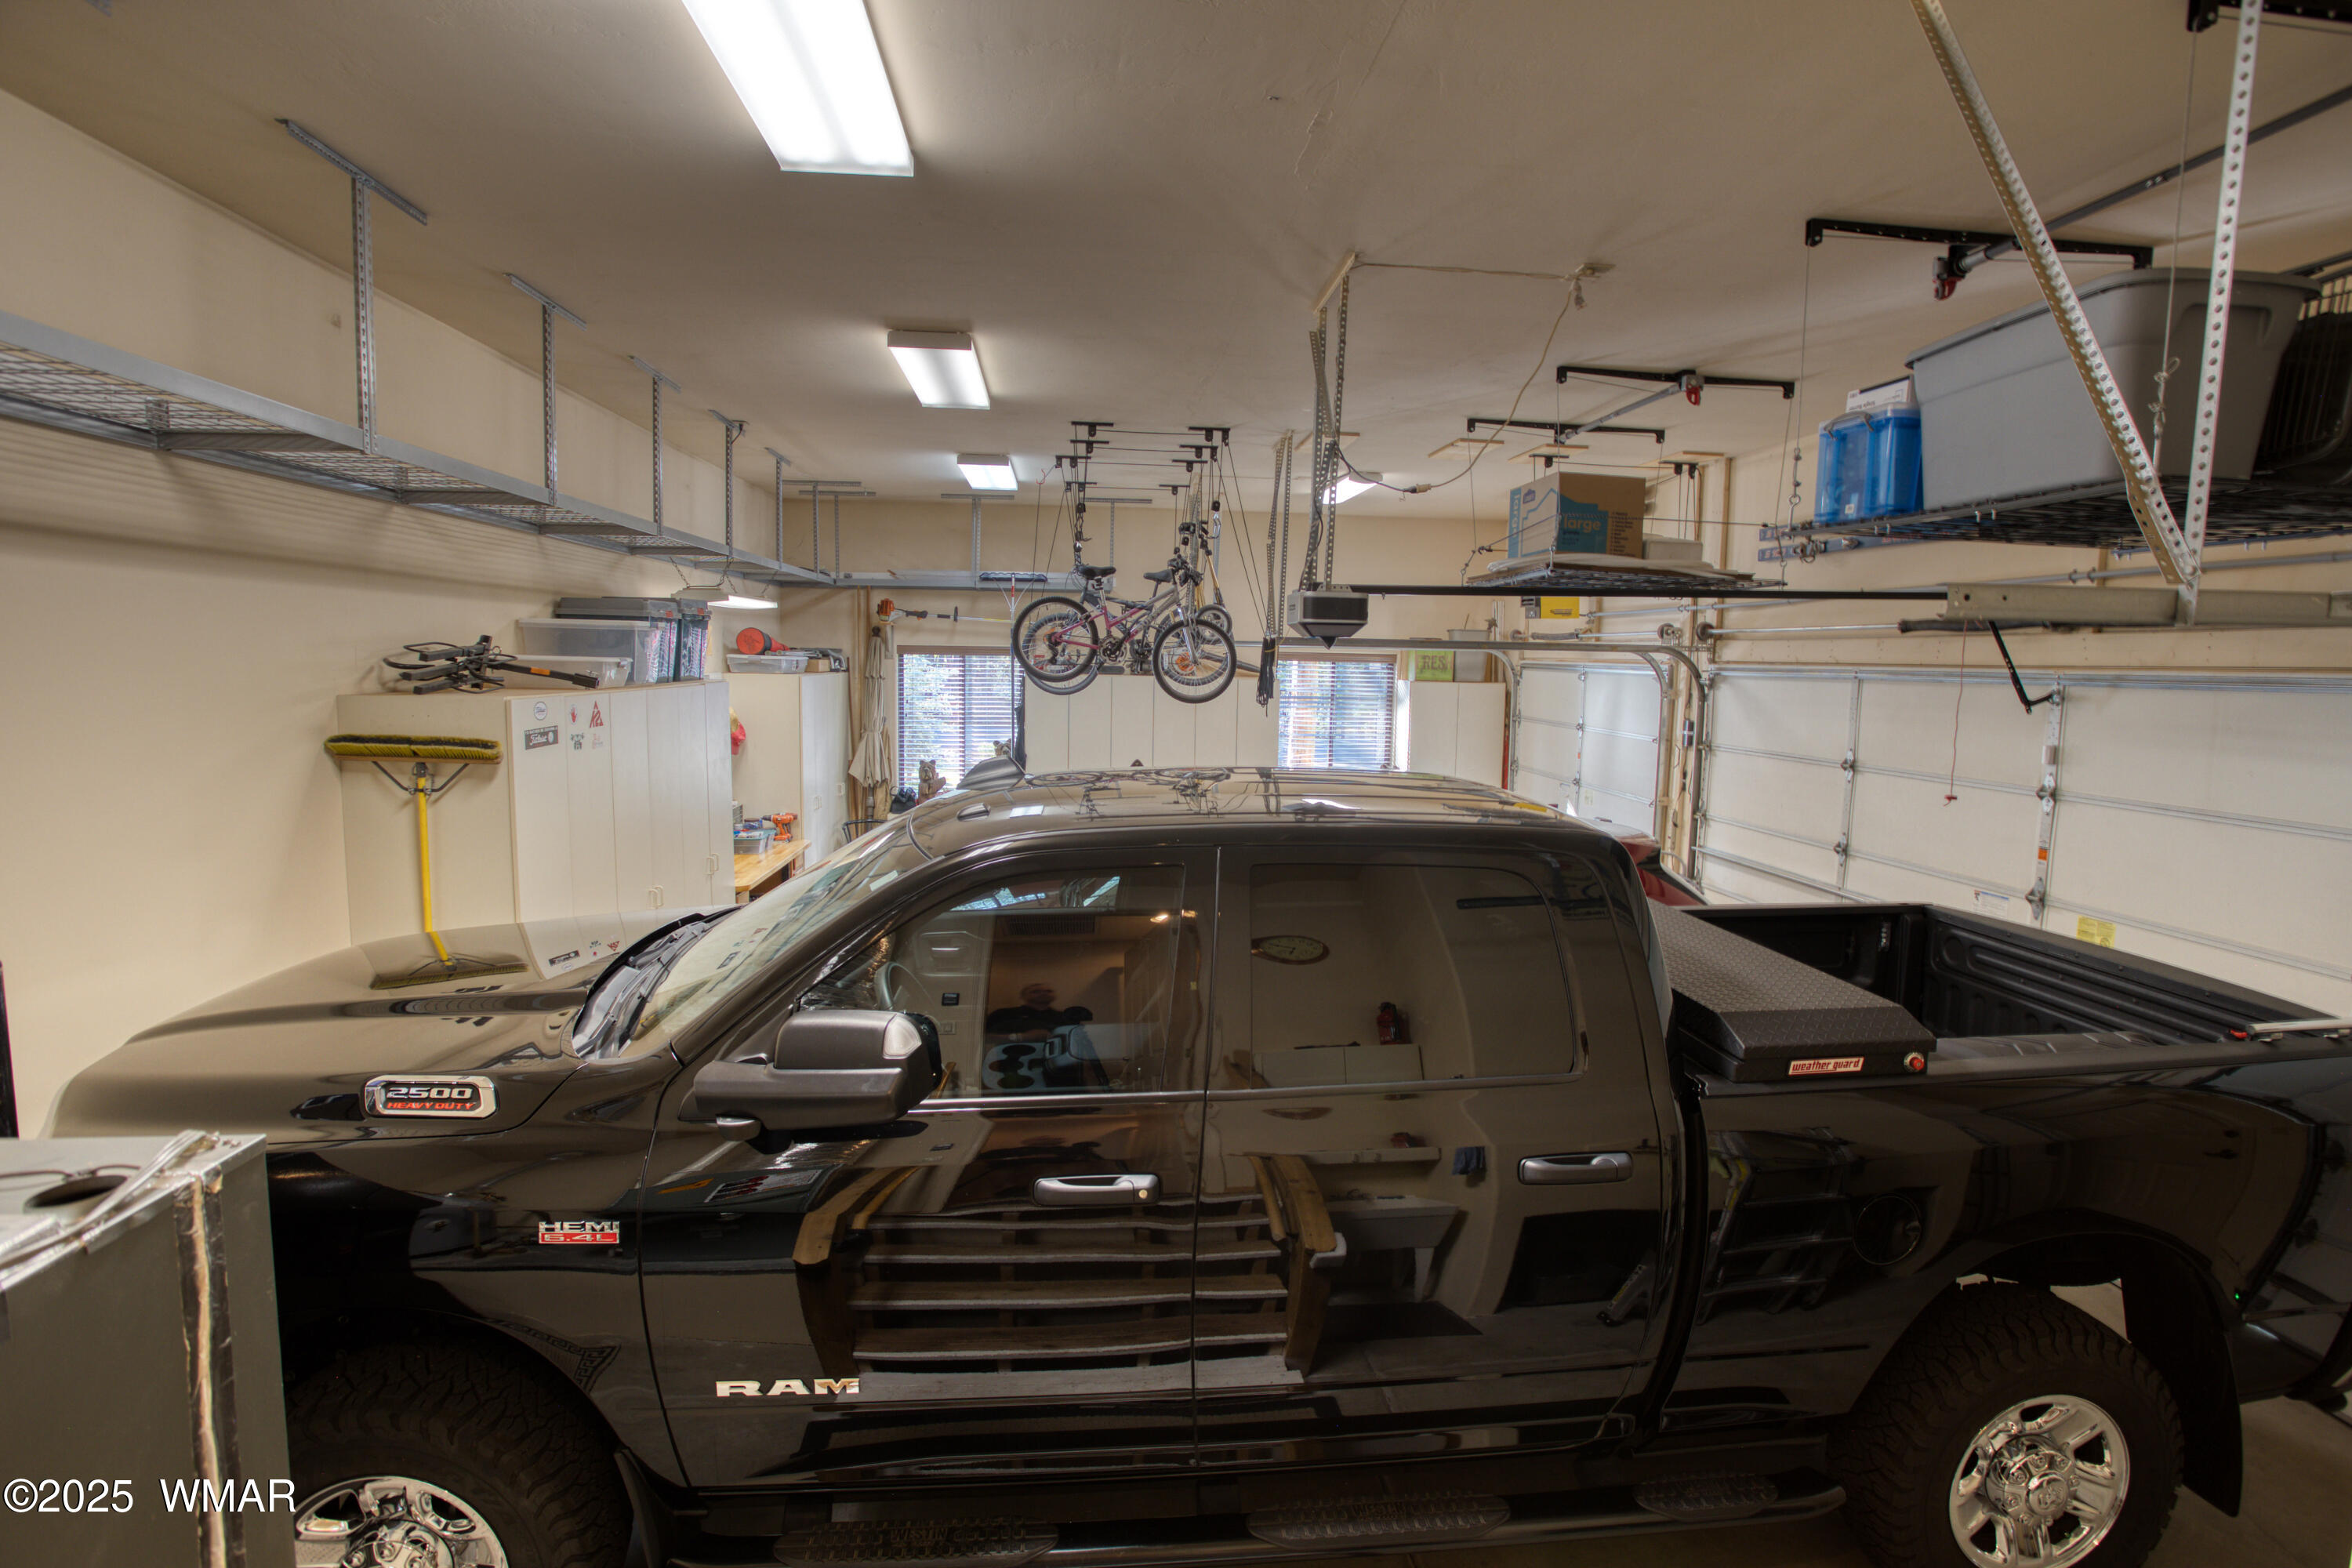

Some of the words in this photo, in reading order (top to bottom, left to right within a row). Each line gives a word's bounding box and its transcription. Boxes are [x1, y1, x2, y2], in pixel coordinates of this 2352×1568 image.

[1563, 514, 1602, 533] large
[1791, 1061, 1830, 1072] weather
[1832, 1058, 1860, 1070] guard
[387, 1087, 473, 1098] 2500
[539, 1221, 620, 1233] HEMI
[715, 1377, 860, 1397] RAM
